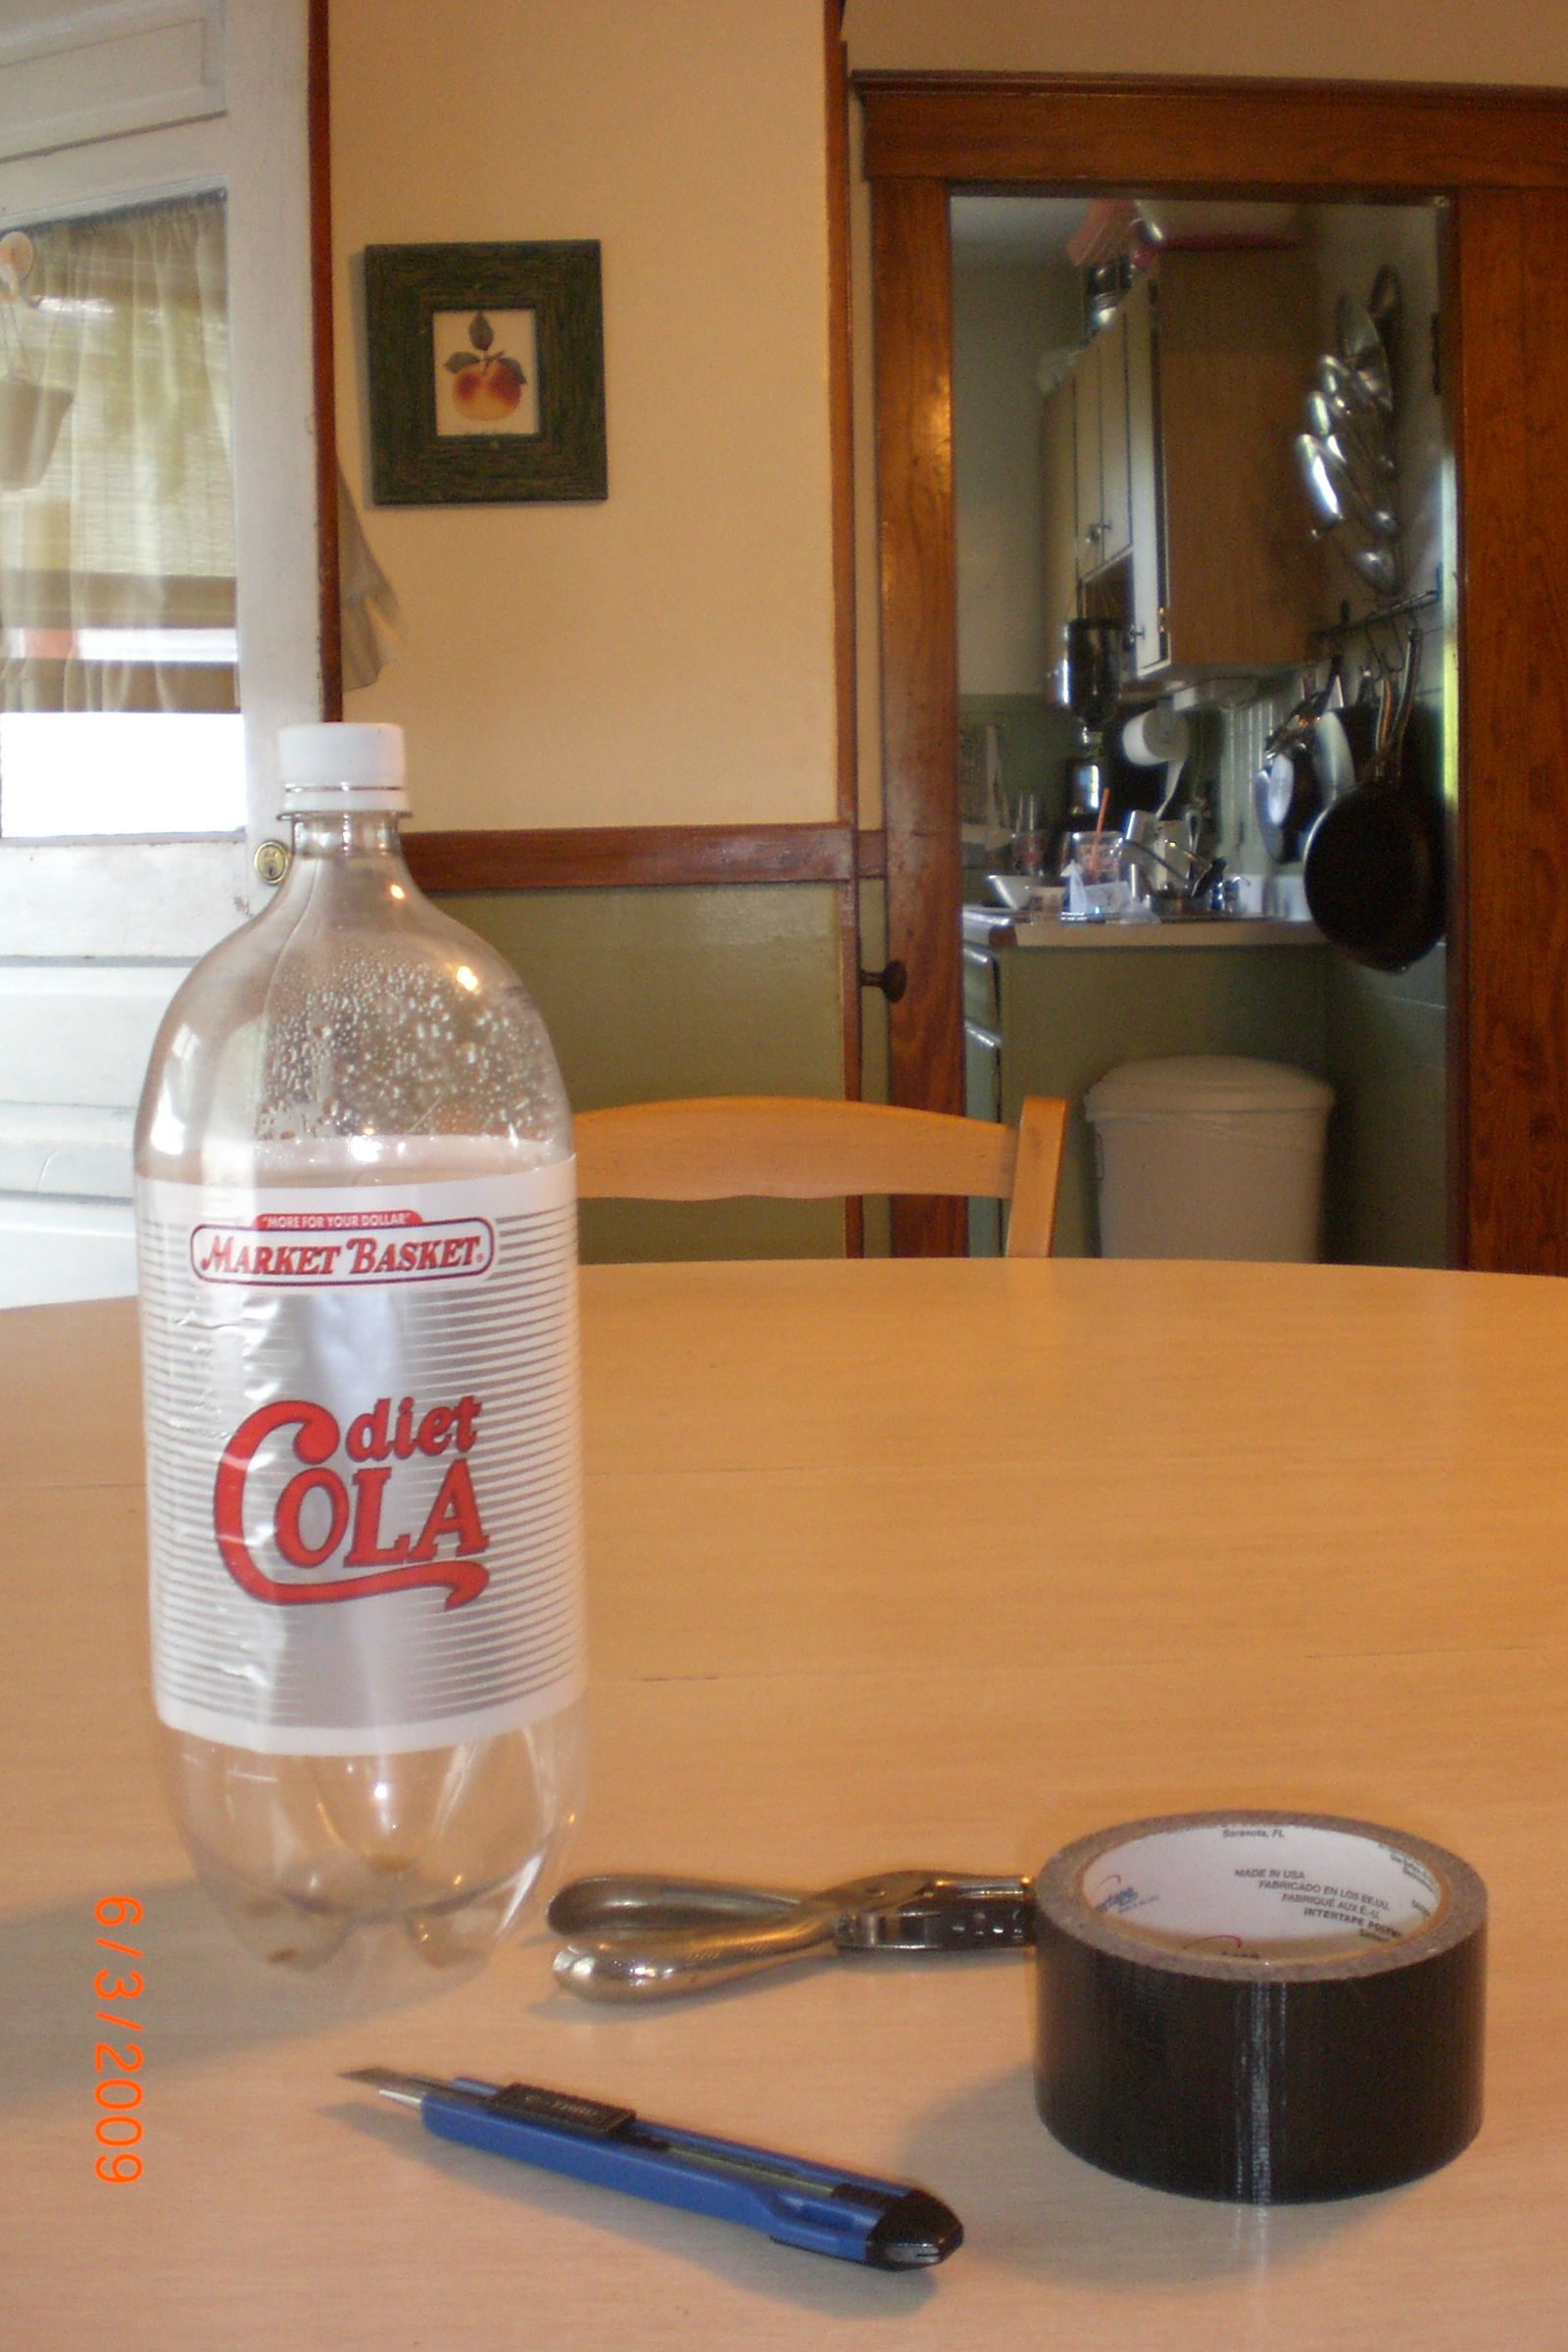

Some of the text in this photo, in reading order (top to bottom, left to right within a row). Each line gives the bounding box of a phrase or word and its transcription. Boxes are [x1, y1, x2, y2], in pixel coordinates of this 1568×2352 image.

[302, 1215, 324, 1228] FOR
[327, 1214, 360, 1227] YOUR
[200, 1234, 342, 1275] MARKET
[345, 1396, 483, 1462] diet
[214, 1398, 490, 1612] COLA
[1235, 1868, 1305, 1880] MADE IN USA
[1258, 1880, 1321, 1893] FABRICADO
[1323, 1886, 1339, 1896] EN
[1340, 1888, 1359, 1901] LOS
[1303, 1907, 1364, 1927] INTERTAPE
[1338, 1901, 1357, 1913] AUX
